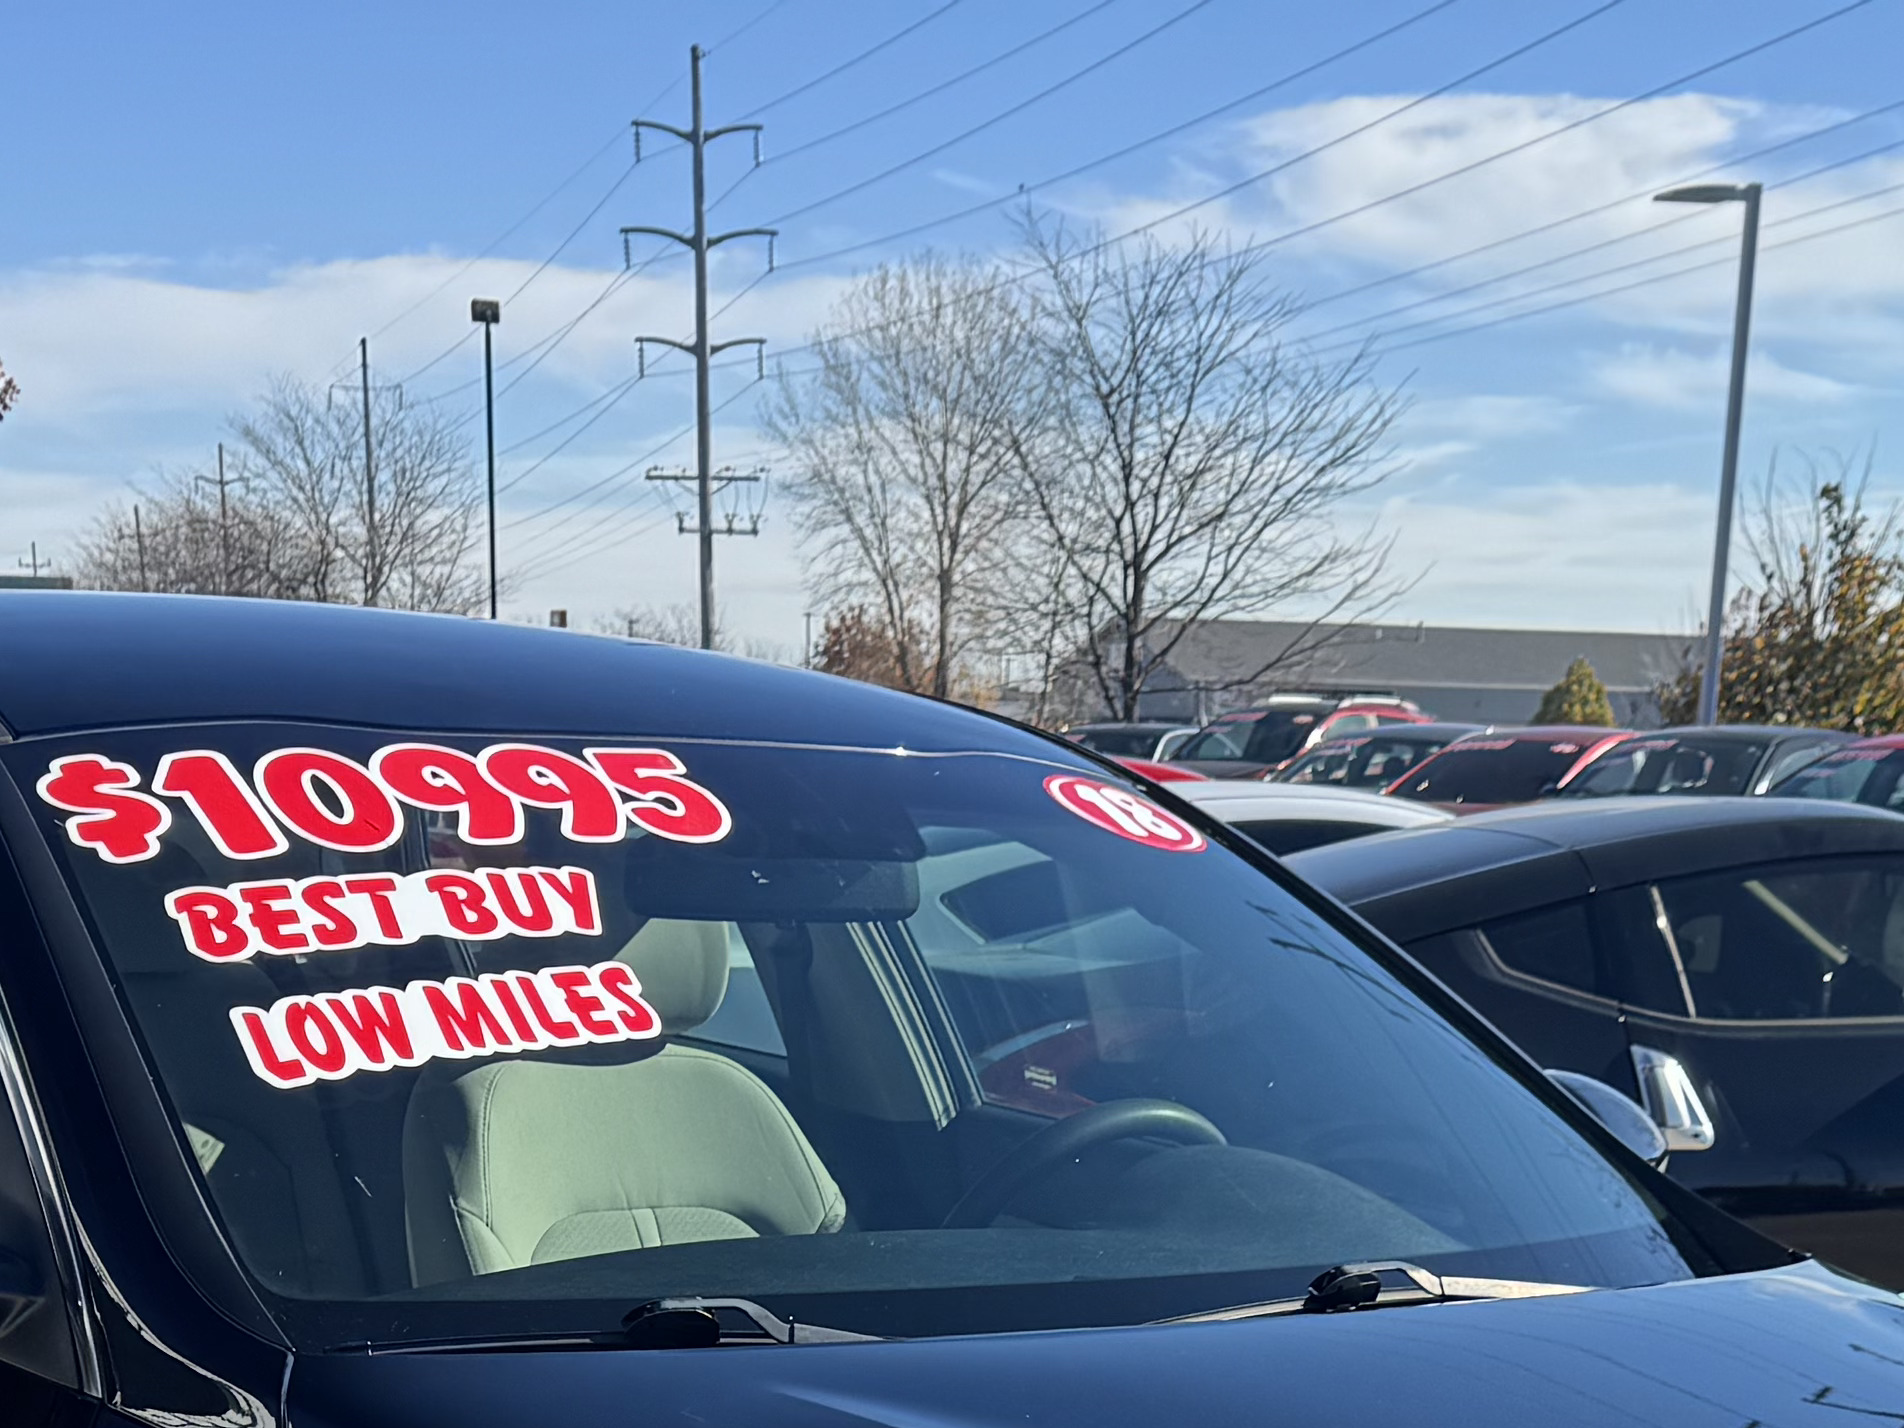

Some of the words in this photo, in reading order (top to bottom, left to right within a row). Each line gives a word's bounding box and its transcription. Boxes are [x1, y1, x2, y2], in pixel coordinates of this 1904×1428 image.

[40, 743, 730, 862] $10995
[169, 874, 406, 960] BEST
[422, 869, 599, 938] BUY
[235, 988, 416, 1084] LOW
[420, 963, 658, 1053] MILES
